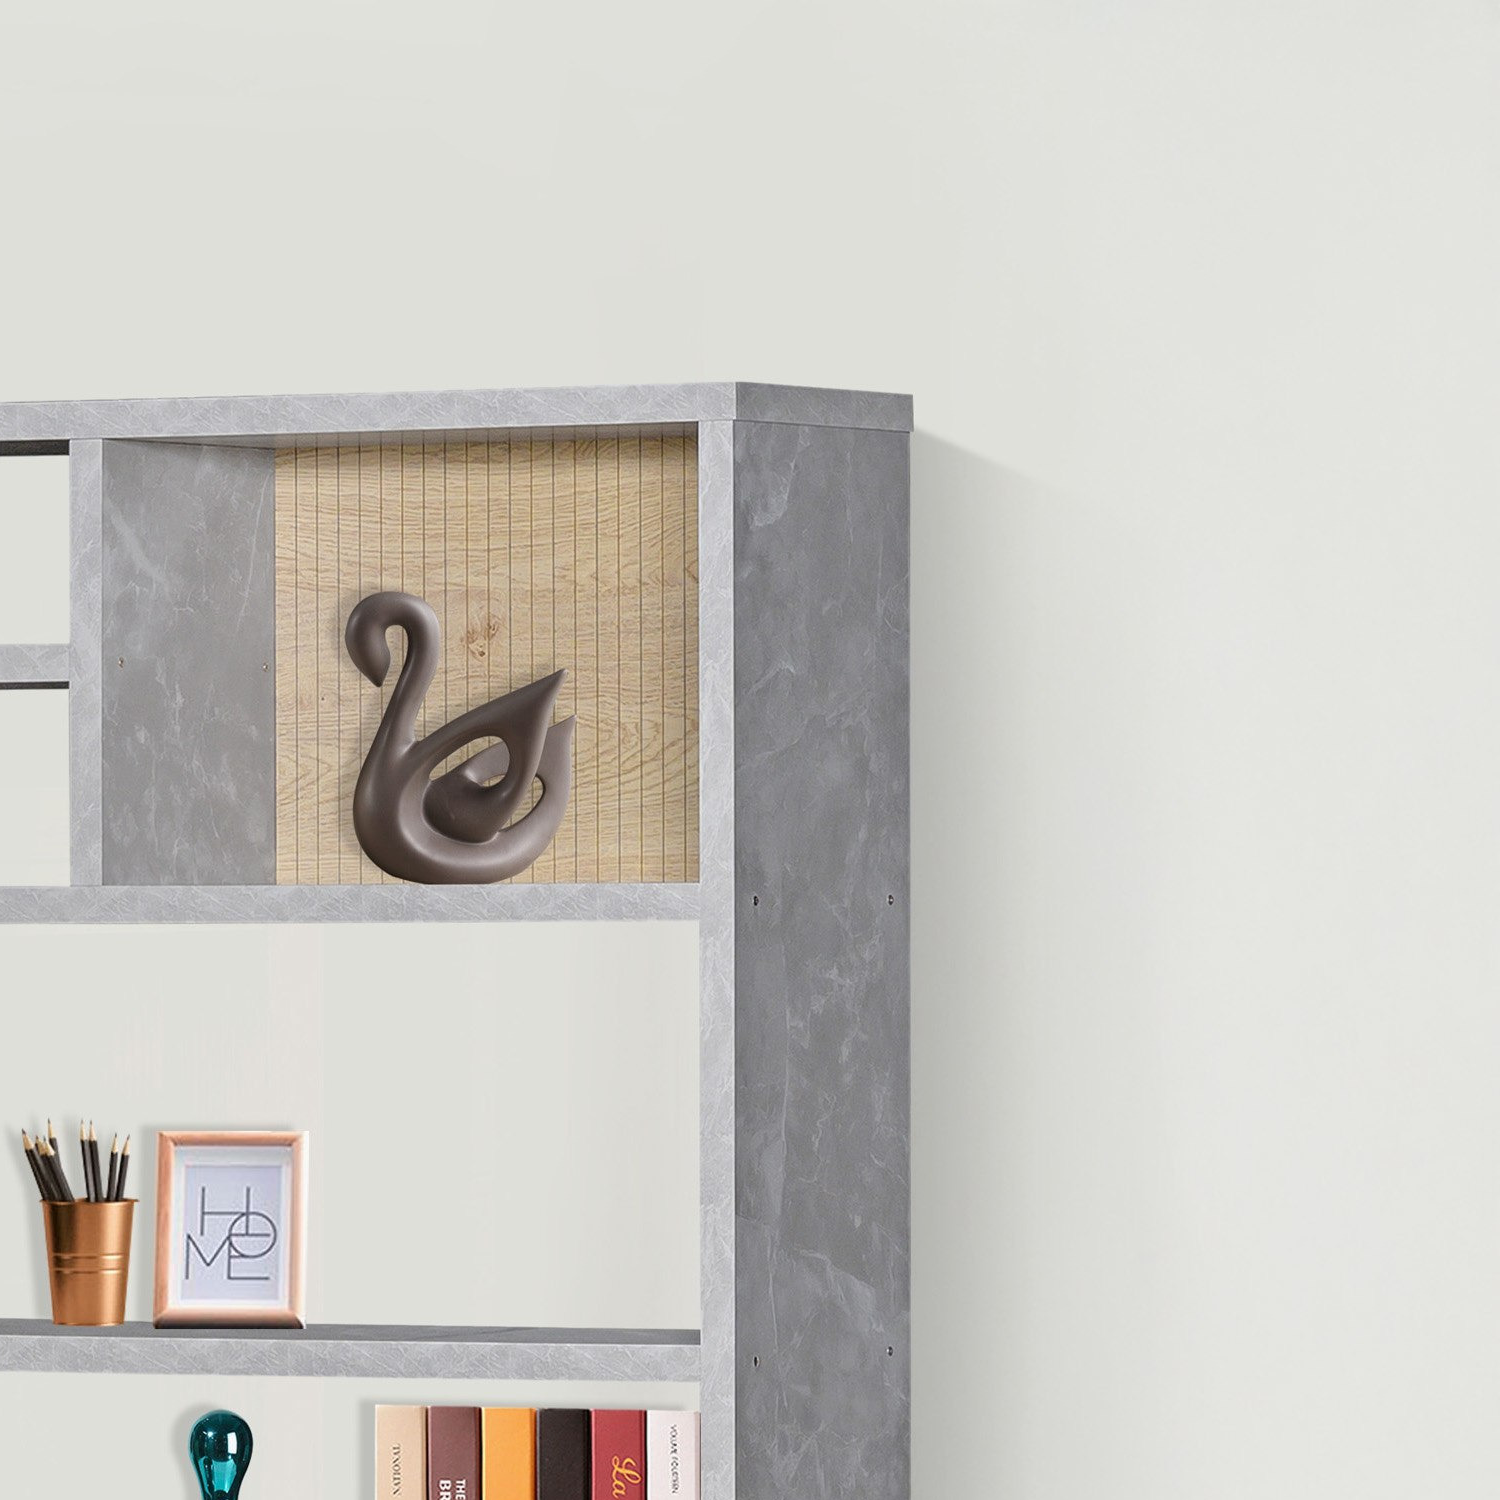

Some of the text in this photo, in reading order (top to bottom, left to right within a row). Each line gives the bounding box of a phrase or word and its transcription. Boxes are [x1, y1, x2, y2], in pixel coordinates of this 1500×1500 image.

[392, 1443, 402, 1496] NATIONAL
[455, 1479, 466, 1500] THE
[612, 1456, 641, 1499] La
